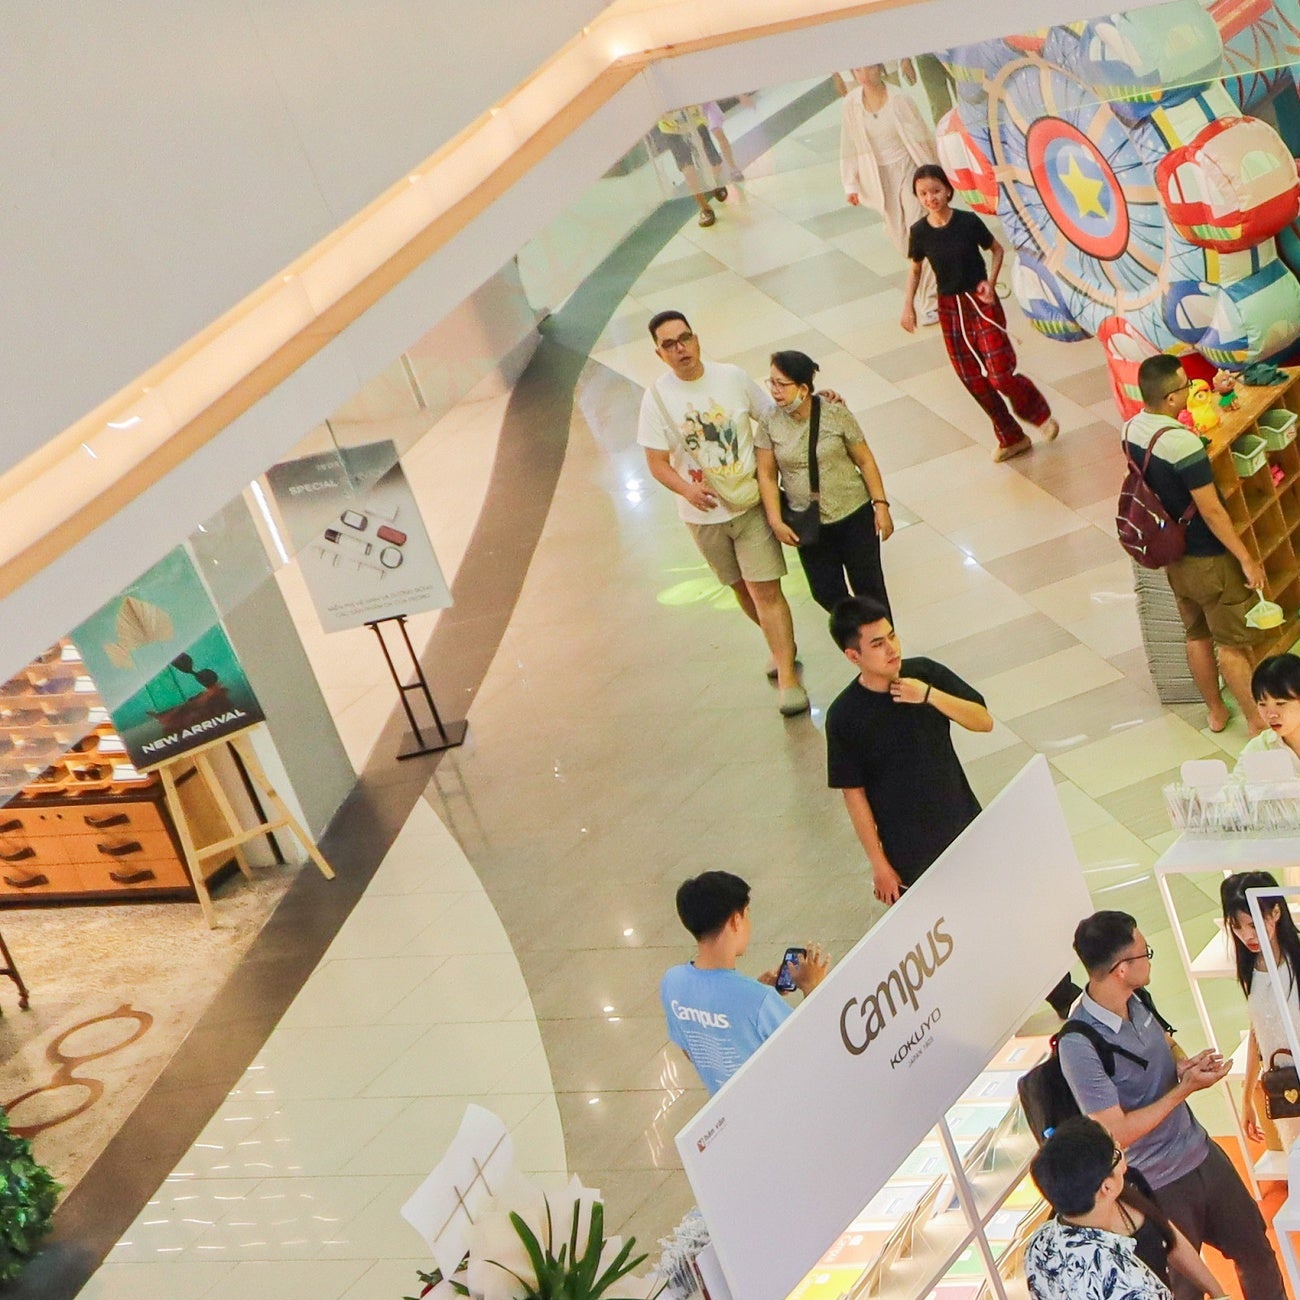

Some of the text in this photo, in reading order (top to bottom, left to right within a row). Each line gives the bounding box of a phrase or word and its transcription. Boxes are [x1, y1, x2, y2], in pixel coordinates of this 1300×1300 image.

[141, 708, 247, 755] NEW ARRIVAL
[839, 916, 955, 1057] Campus
[671, 1000, 730, 1028] Campus
[889, 1008, 942, 1070] KOKUYO
